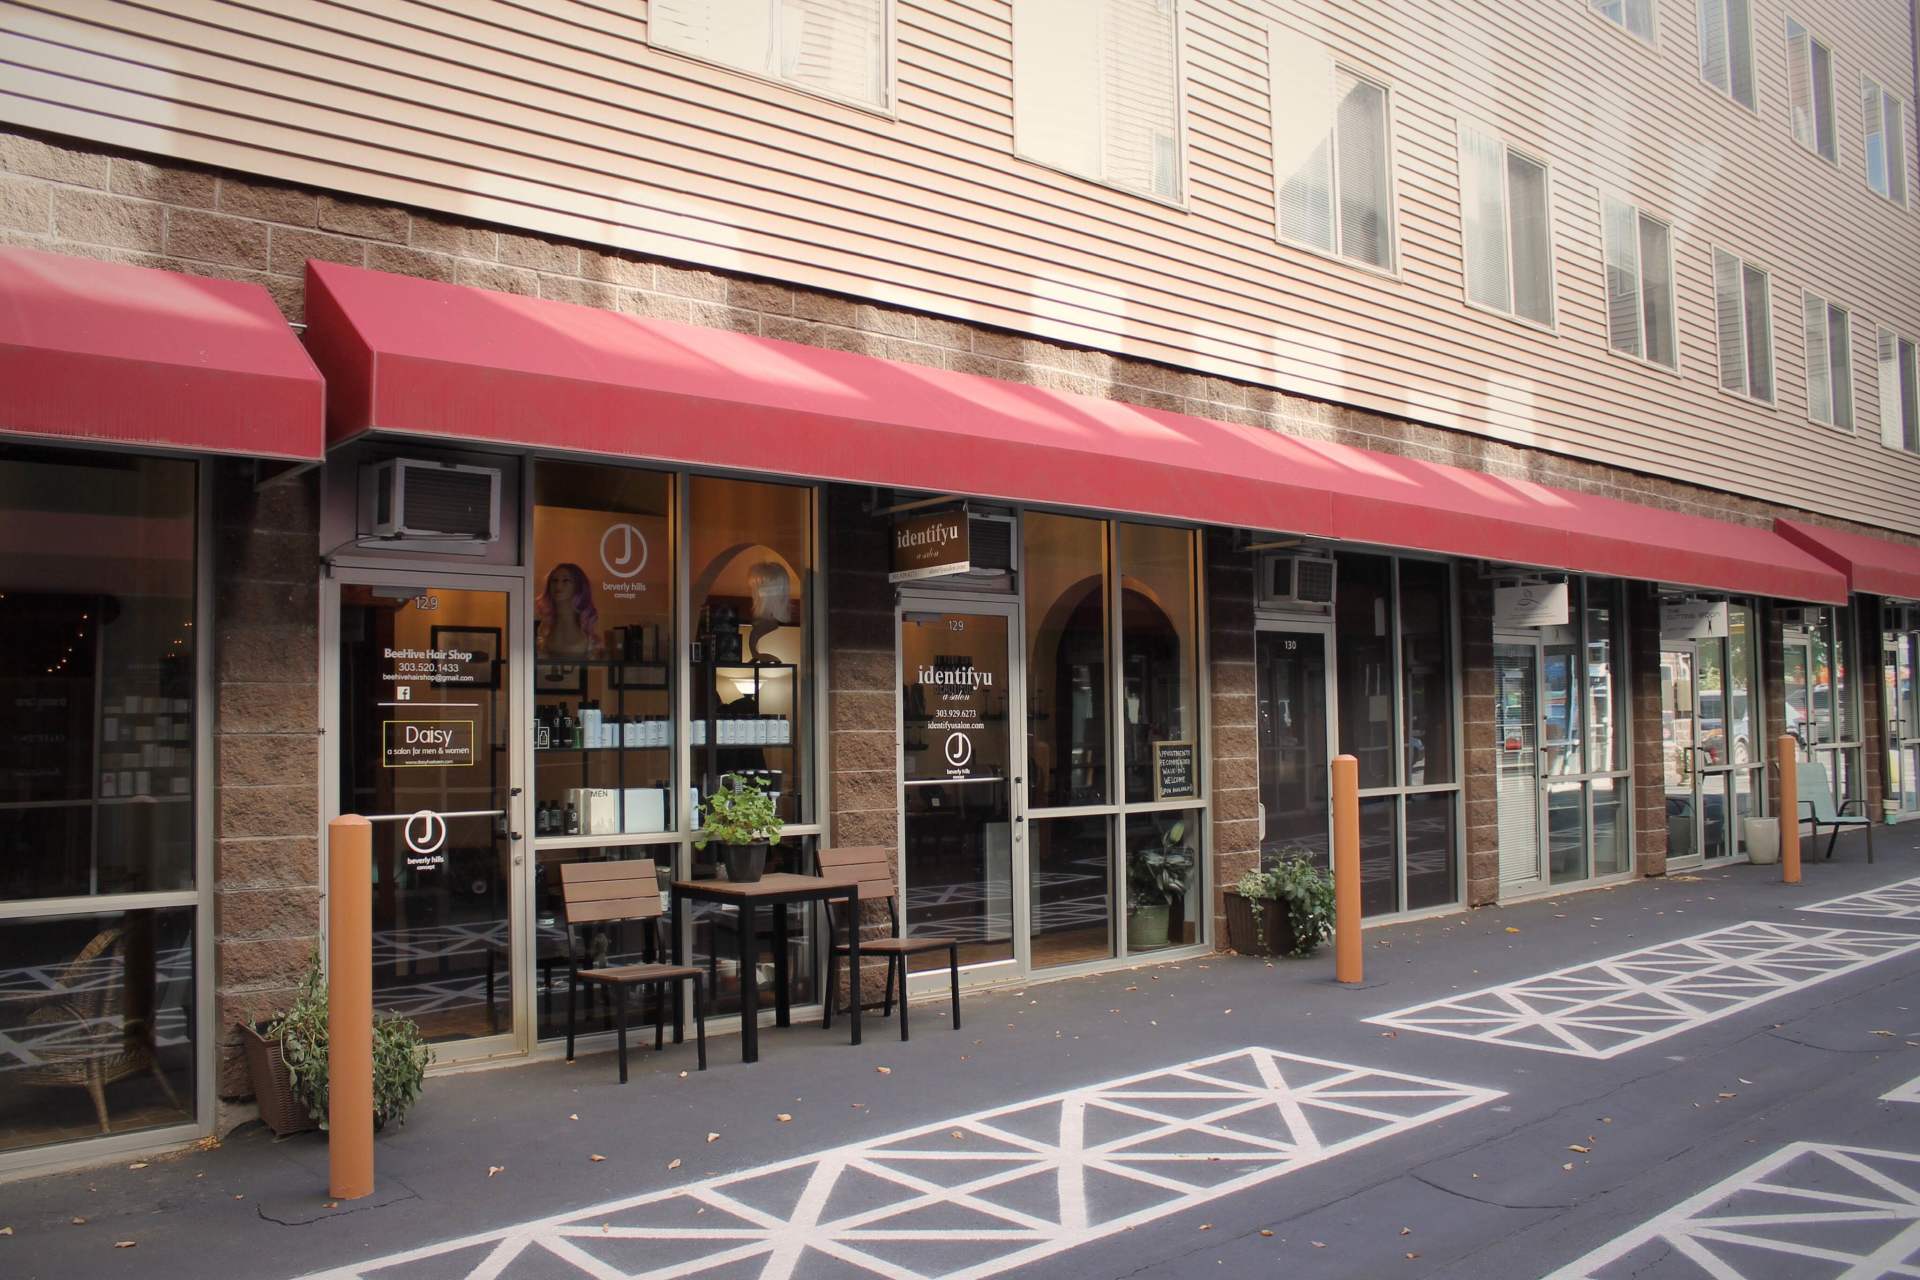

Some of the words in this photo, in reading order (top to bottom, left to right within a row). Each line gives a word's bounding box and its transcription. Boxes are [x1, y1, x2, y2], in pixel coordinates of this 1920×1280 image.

[897, 523, 959, 549] identifyu
[602, 582, 630, 593] beverly
[631, 582, 647, 592] hills
[415, 596, 438, 610] 129
[948, 620, 965, 631] 129
[1285, 640, 1297, 650] 130
[384, 648, 425, 659] BeeHive
[426, 649, 448, 660] Hair
[448, 650, 473, 663] Shop
[398, 663, 460, 673] 303.520.1433
[382, 673, 474, 682] beehivehairshop@gmail.com
[918, 664, 993, 691] identifyu
[942, 693, 948, 701] a
[949, 690, 970, 701] salon
[935, 709, 977, 718] 303.929.6273
[927, 720, 985, 731] identifyusalon.com
[405, 726, 454, 748] Daisy
[393, 746, 412, 756] salon
[412, 747, 422, 756] for
[421, 747, 437, 755] men
[437, 747, 445, 755] &
[445, 747, 470, 755] women
[946, 768, 962, 776] beverly
[590, 789, 609, 798] MEN
[407, 856, 431, 866] beverly
[431, 855, 445, 864] hills
